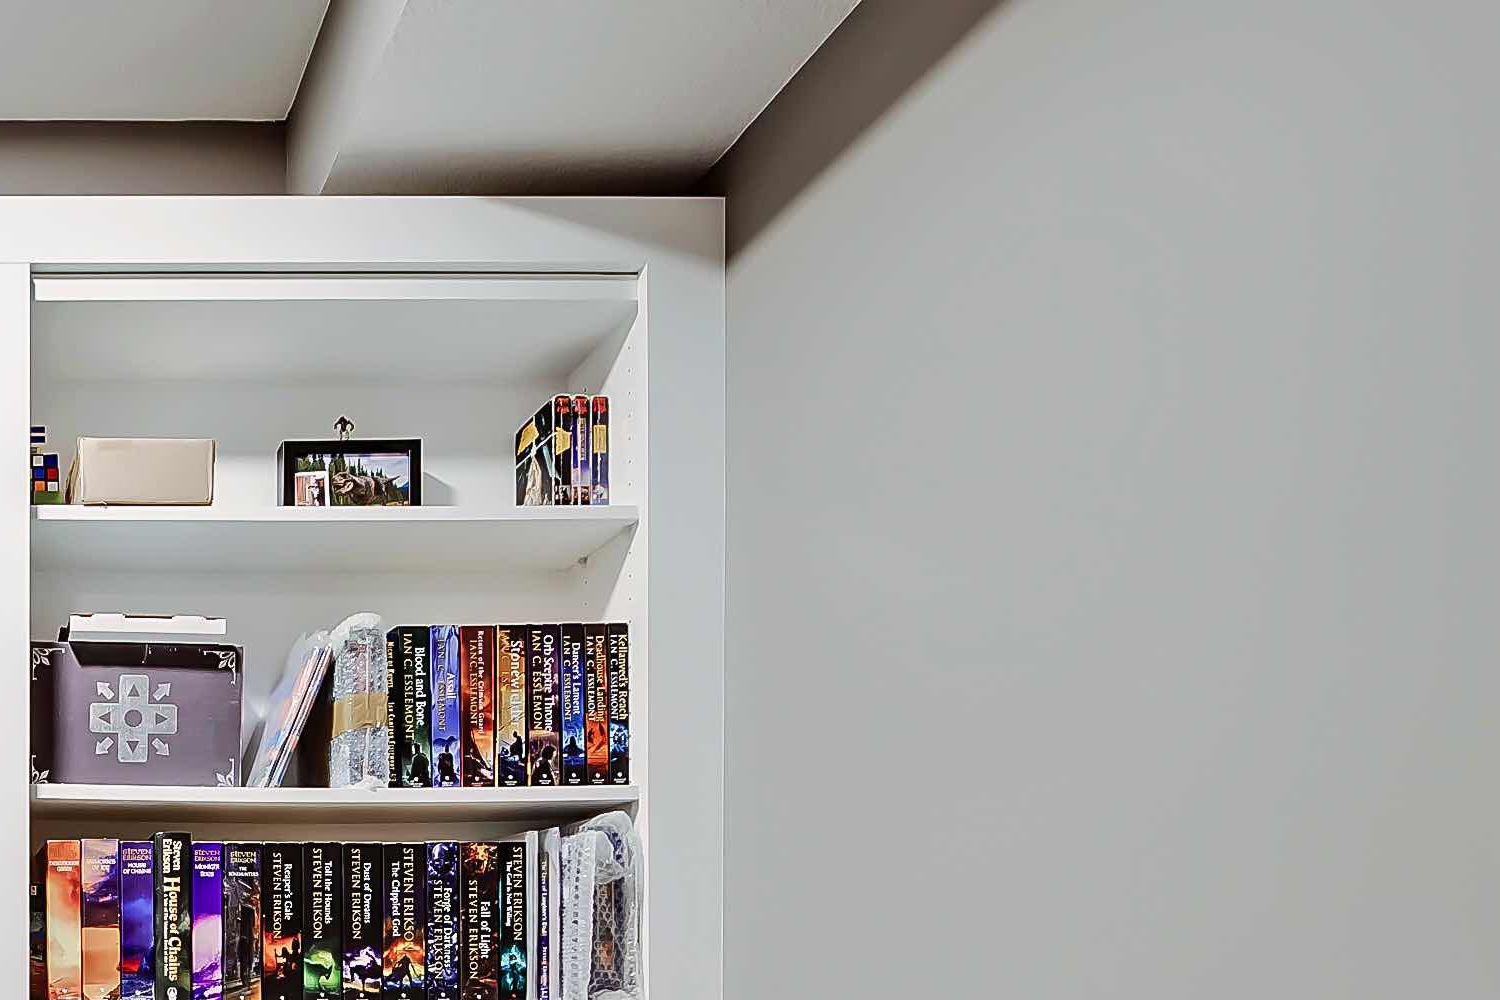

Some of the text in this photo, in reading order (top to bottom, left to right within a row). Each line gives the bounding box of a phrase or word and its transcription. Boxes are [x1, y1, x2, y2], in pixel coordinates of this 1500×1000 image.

[532, 631, 541, 651] IAN
[542, 635, 554, 731] Orb Sceptre Throne
[572, 643, 581, 714] Dancer's Lament
[596, 636, 605, 721] Deadhouse Landing
[618, 634, 628, 720] Kellanved's Reach
[403, 633, 414, 740] IAN ESSLEMONT
[415, 647, 425, 725] Blood and Bone
[162, 839, 172, 873] Erikson
[173, 841, 182, 870] Steven
[273, 853, 281, 939] STEVEN ERIKSON
[283, 864, 293, 920] Reaper's Gale
[313, 848, 322, 939] STEVEN ERIKSON
[352, 849, 361, 939] STEVEN ERIKSON
[364, 883, 372, 892] of
[390, 880, 400, 915] Crippled
[513, 847, 522, 941] STEVEN ERIKSON
[163, 877, 181, 981] House of Chains
[392, 919, 400, 936] God
[403, 848, 414, 950] STEVEN ERIKSON
[434, 880, 443, 979] STEVEN ERIKSON
[442, 888, 452, 967] Forge of Darkness
[468, 880, 478, 979] STEVEN ERIKSON
[479, 902, 490, 958] Fall of Light
